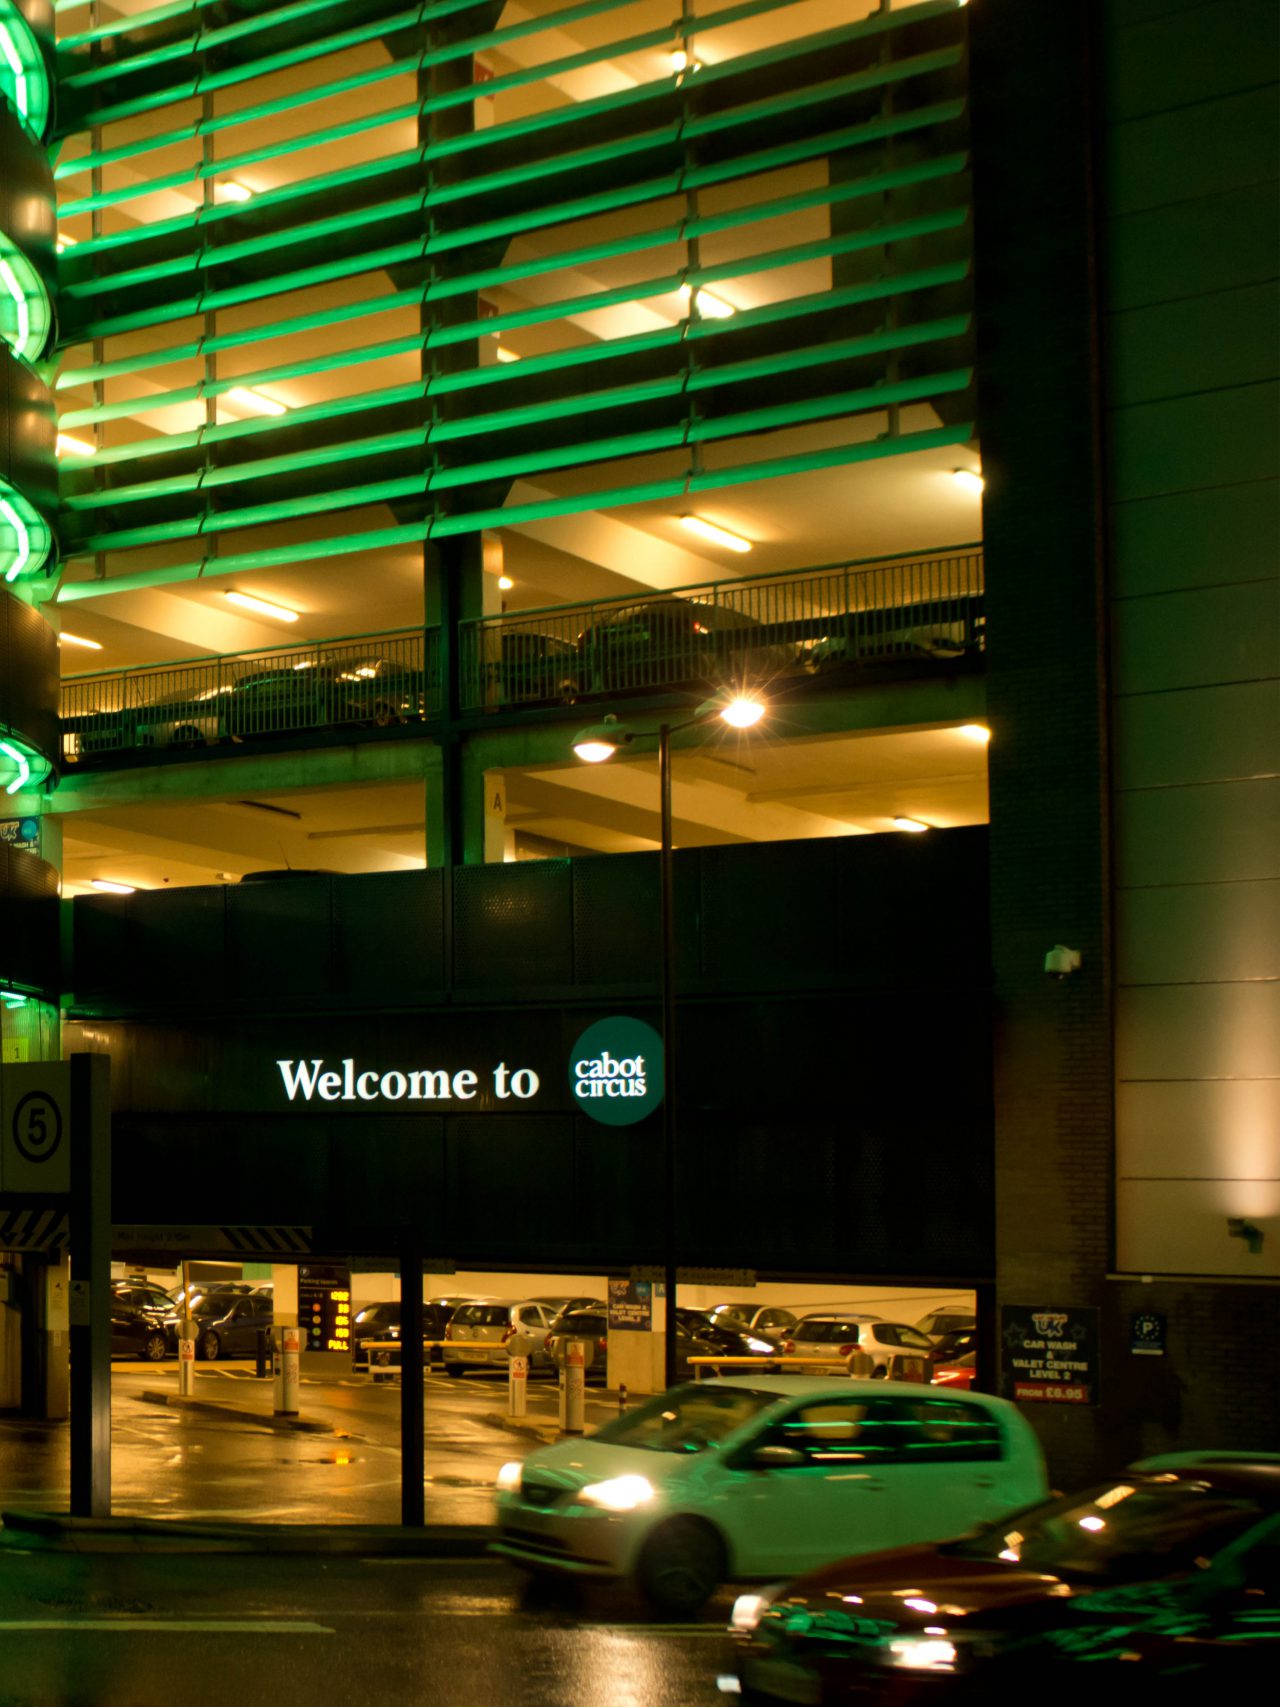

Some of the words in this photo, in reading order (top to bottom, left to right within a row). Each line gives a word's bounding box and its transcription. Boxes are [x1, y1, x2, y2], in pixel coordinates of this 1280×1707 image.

[493, 792, 503, 811] A
[575, 1052, 646, 1078] cabot
[277, 1058, 477, 1101] Welcome
[492, 1061, 540, 1100] to
[575, 1075, 647, 1098] circus
[28, 1108, 46, 1145] 5
[1142, 1321, 1153, 1334] P
[328, 1340, 349, 1351] FULL
[1023, 1340, 1045, 1349] CAR
[1047, 1341, 1077, 1350] WASH
[1012, 1358, 1044, 1369] VALET
[1046, 1360, 1088, 1371] CENTRE
[1029, 1369, 1062, 1379] LEVEL
[1063, 1370, 1072, 1380] 2
[1016, 1388, 1043, 1398] FROM
[1045, 1387, 1082, 1399] £6.95
